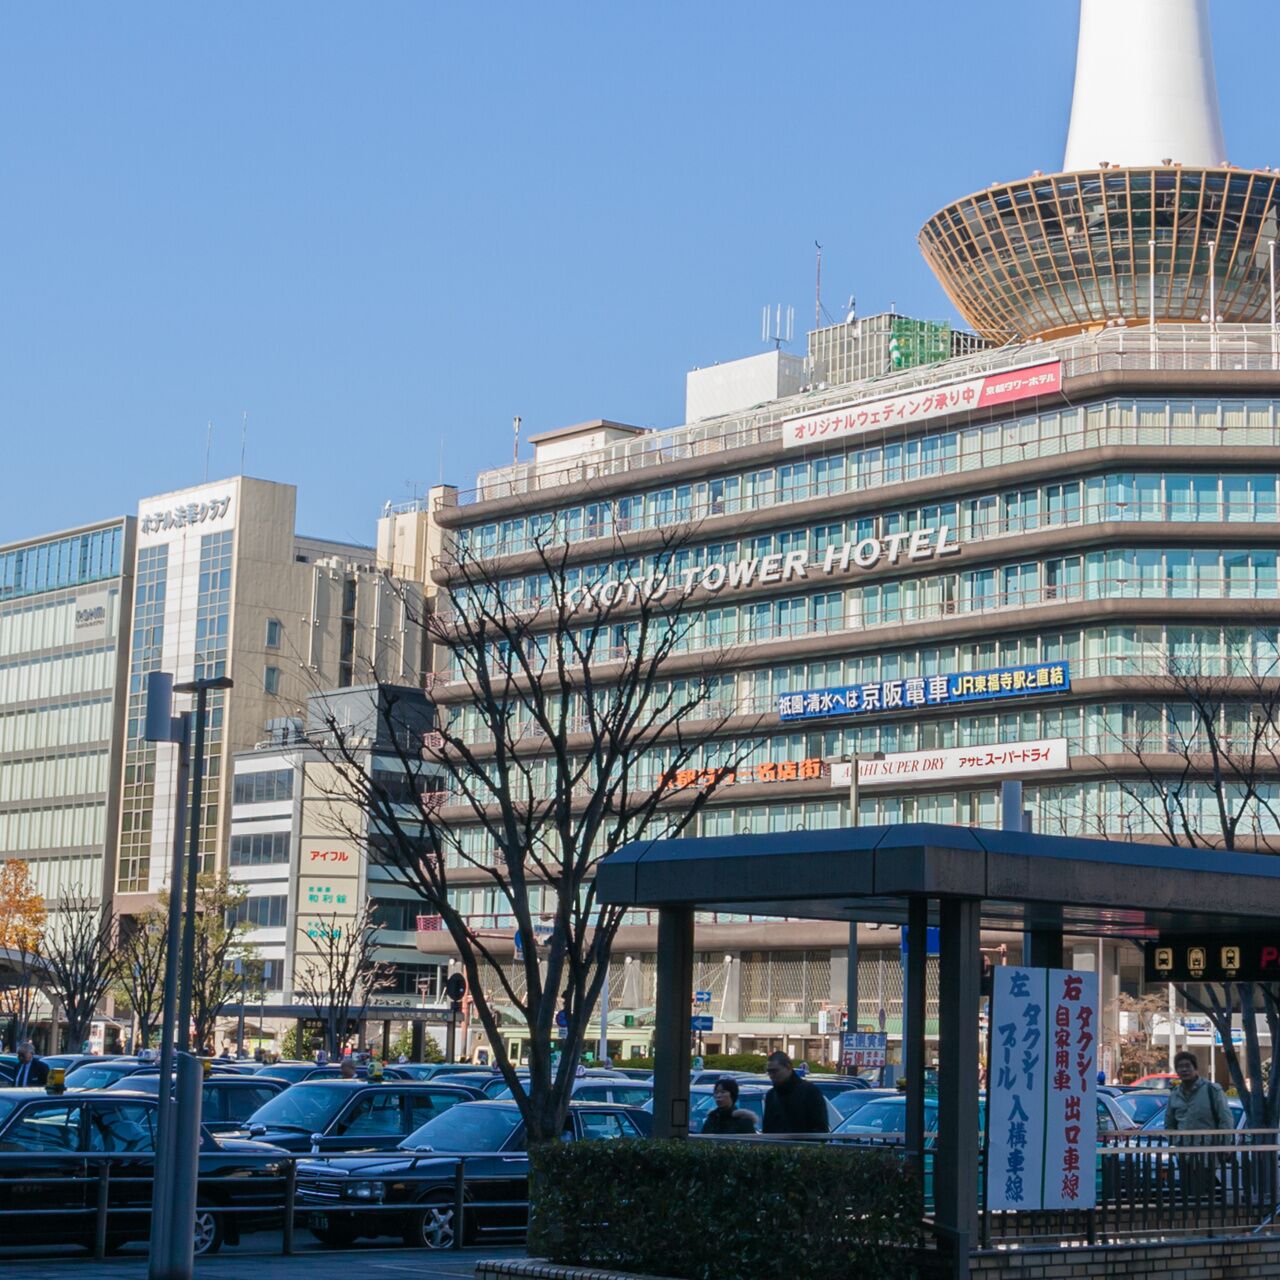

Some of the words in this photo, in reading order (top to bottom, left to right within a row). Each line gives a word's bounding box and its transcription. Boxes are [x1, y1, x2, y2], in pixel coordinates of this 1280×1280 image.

[794, 387, 976, 440] オリジナルウェディング承り中
[985, 372, 1056, 397] 京都タワーホテル
[140, 496, 231, 535] ホテル法華クラブ
[680, 549, 810, 595] TOWER
[822, 525, 960, 574] HOTEL
[860, 676, 949, 710] 京阪電車
[951, 666, 1063, 696] JR東福寺駅と直結
[841, 760, 879, 778] AAHI
[881, 759, 919, 775] SUPER
[922, 757, 946, 771] DRY
[985, 747, 1051, 765] スーパードライ
[310, 851, 349, 862] アイフル
[1009, 971, 1031, 998] 左
[1062, 974, 1084, 1002] 右
[997, 1022, 1017, 1091] プール
[1021, 1002, 1042, 1091] タクシー
[1053, 1004, 1072, 1091] 自家用車
[1076, 1005, 1094, 1093] タクシー
[1004, 1094, 1030, 1203] 入構車線
[1061, 1095, 1081, 1201] 出口車線
